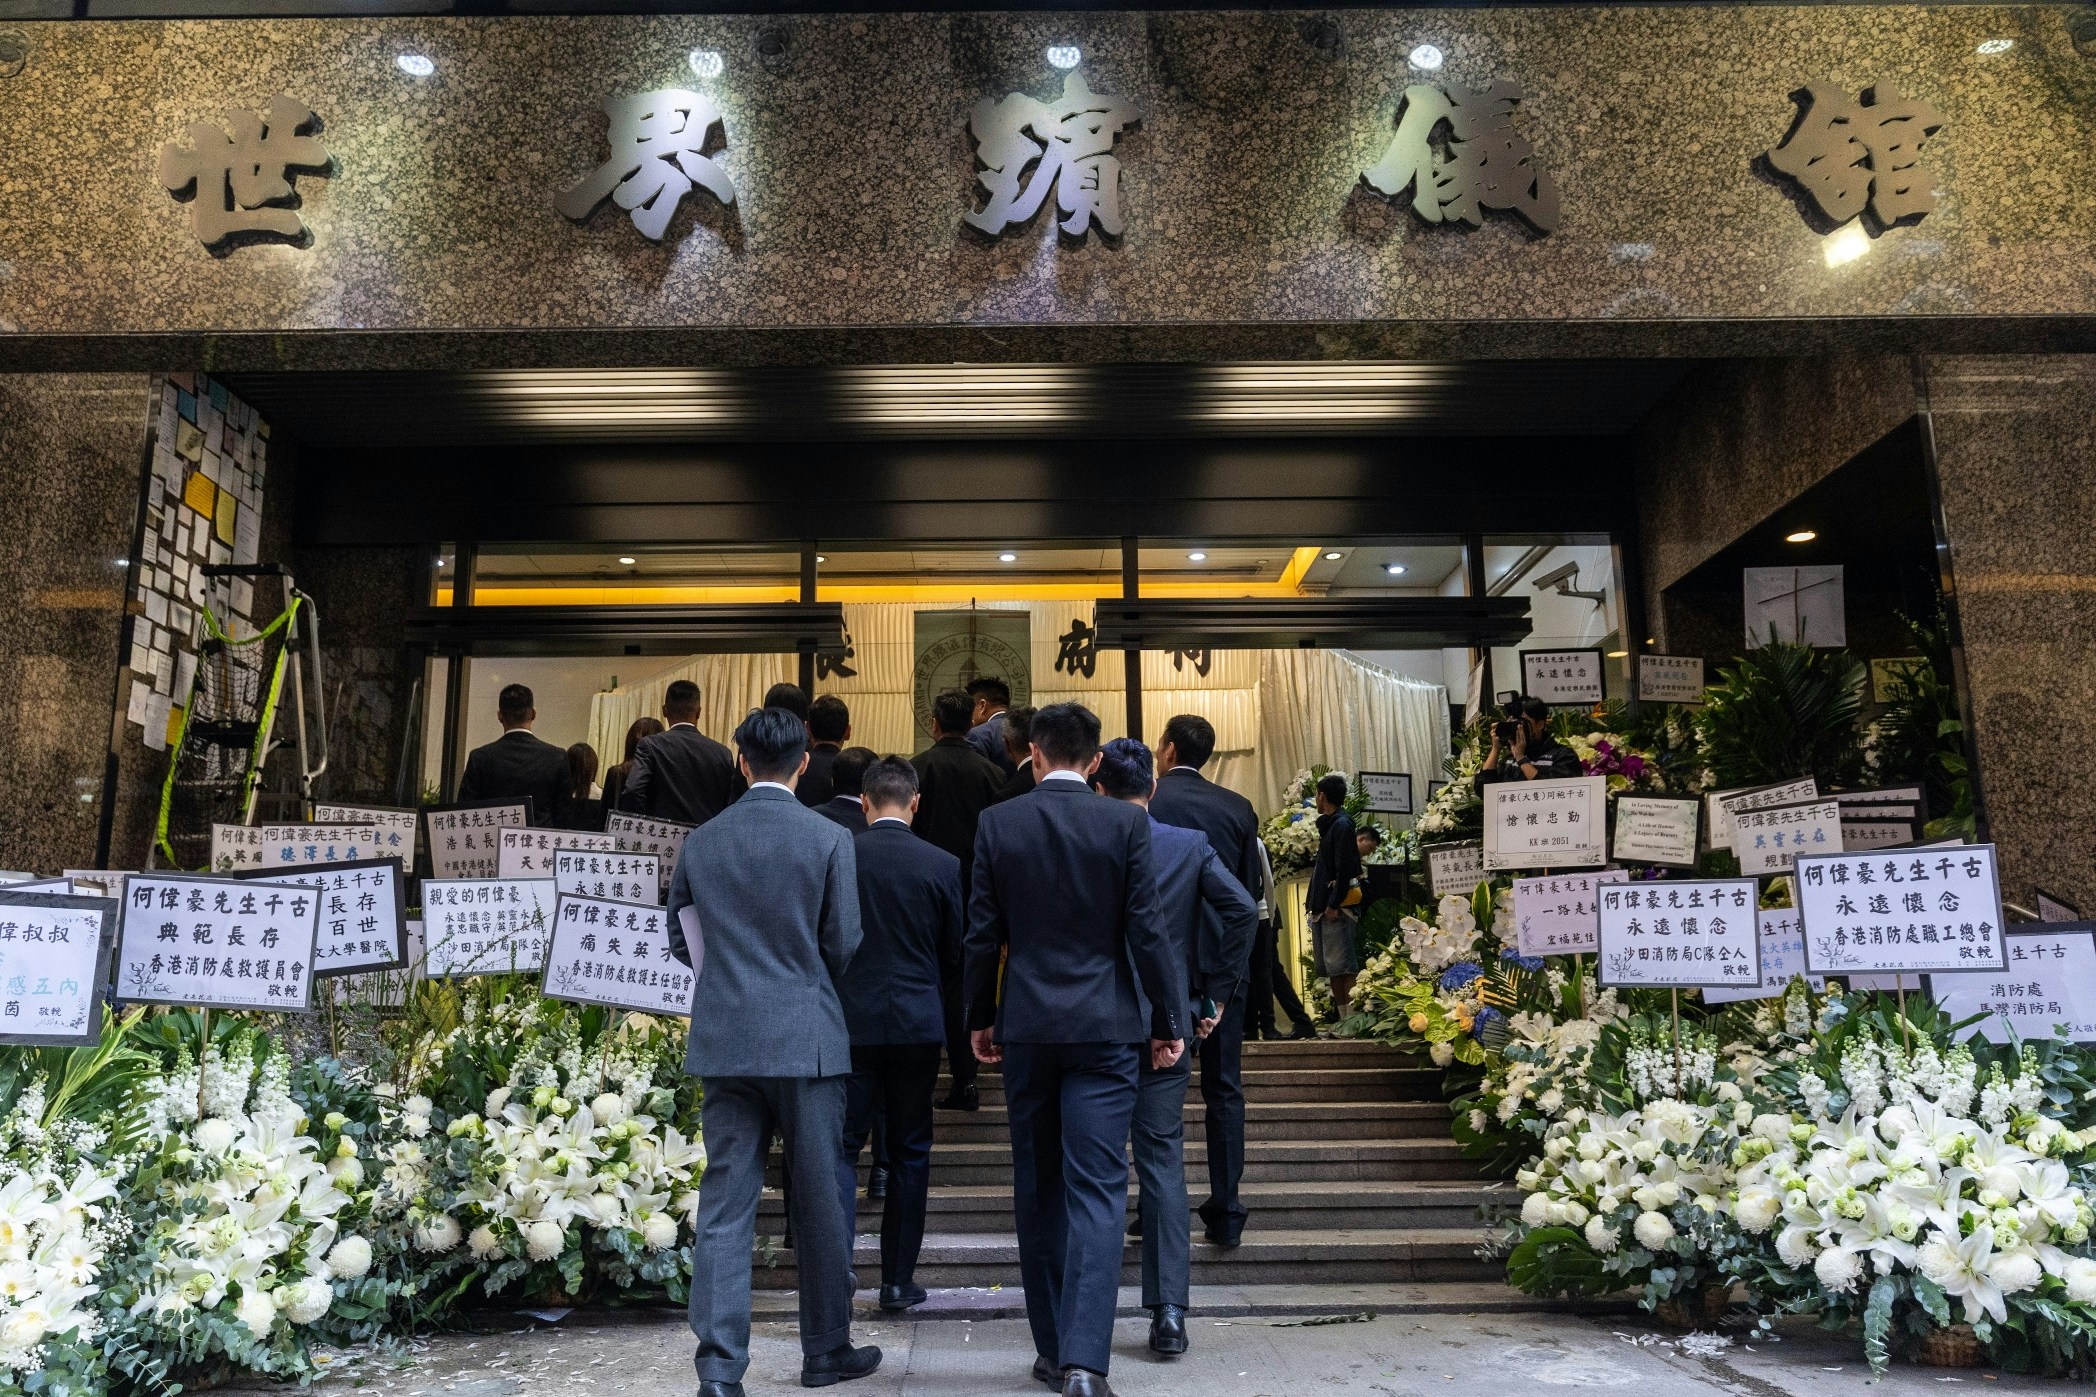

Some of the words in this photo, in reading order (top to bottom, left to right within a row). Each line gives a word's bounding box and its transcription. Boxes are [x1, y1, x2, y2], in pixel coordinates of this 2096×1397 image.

[159, 70, 1946, 242] 世界殯儀館
[1536, 668, 1586, 679] 永遠懷念
[1723, 782, 1814, 813] 何偉豪先生千古
[434, 809, 521, 831] 何偉豪先生千古
[1737, 805, 1837, 829] 何偉豪先生千古
[265, 828, 373, 841] 何偉豪先生千古
[446, 832, 495, 850] 浩氣長
[1529, 838, 1538, 846] KK
[1552, 837, 1569, 845] 2051
[559, 856, 655, 876] 何偉豪先生千古
[1764, 851, 1806, 867] 規劃
[1804, 856, 1983, 887] 何偉豪先生千古
[277, 871, 386, 892] 先生千古
[575, 882, 642, 898] 永遠懷念
[132, 885, 310, 918] 何偉豪先生千古
[327, 892, 378, 915] 長存
[429, 886, 521, 905] 親愛的何偉豪
[1604, 888, 1748, 910] 何偉豪先生千古
[1836, 890, 1961, 916] 永遠懷念
[328, 916, 378, 936] 百世
[444, 911, 491, 923] 永遠懷念
[564, 902, 668, 934] 何偉豪先生
[1627, 917, 1728, 936] 永遠懷念
[156, 922, 280, 949] 典範長存
[1760, 919, 1802, 936] 生千古
[1834, 921, 1994, 946] 香港消防處職工總會
[315, 940, 389, 958] 文大學醫院
[580, 933, 672, 962] 痛失英才
[1959, 946, 1993, 959] 敬輓
[2011, 943, 2067, 960] 生千古
[149, 953, 305, 982] 香港消防處救護員會
[571, 959, 693, 991] 香港消防處救護主任協會
[1723, 964, 1750, 976] 敬輓
[267, 984, 298, 998] 敬輓
[662, 992, 687, 1005] 敬輓
[1991, 982, 2043, 997] 消防處
[4, 1000, 20, 1017] 茵
[38, 1007, 62, 1017] 敬輓
[1980, 1002, 2062, 1016] 馬灣消防局
